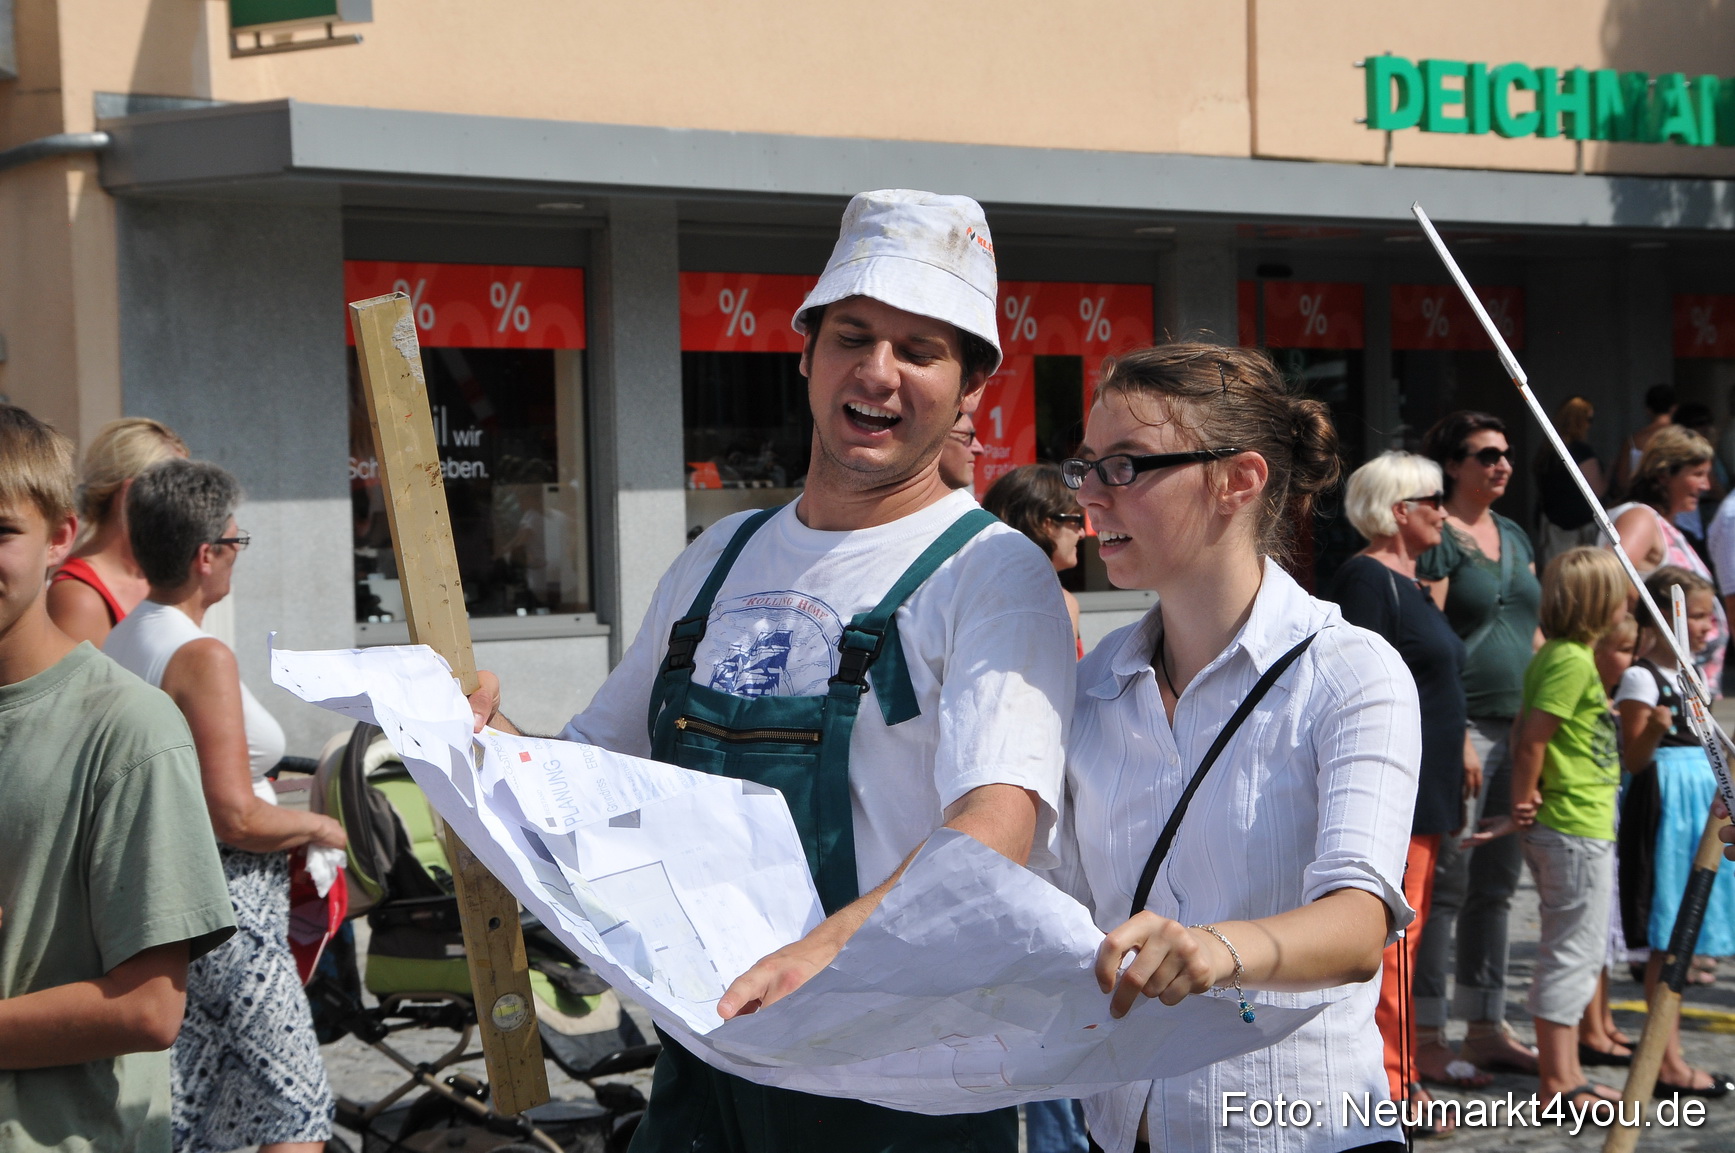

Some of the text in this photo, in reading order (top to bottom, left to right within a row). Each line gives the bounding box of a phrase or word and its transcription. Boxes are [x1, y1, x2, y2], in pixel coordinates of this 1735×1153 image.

[452, 425, 484, 447] wir
[989, 405, 1004, 440] 1
[542, 759, 584, 827] PLANUNG
